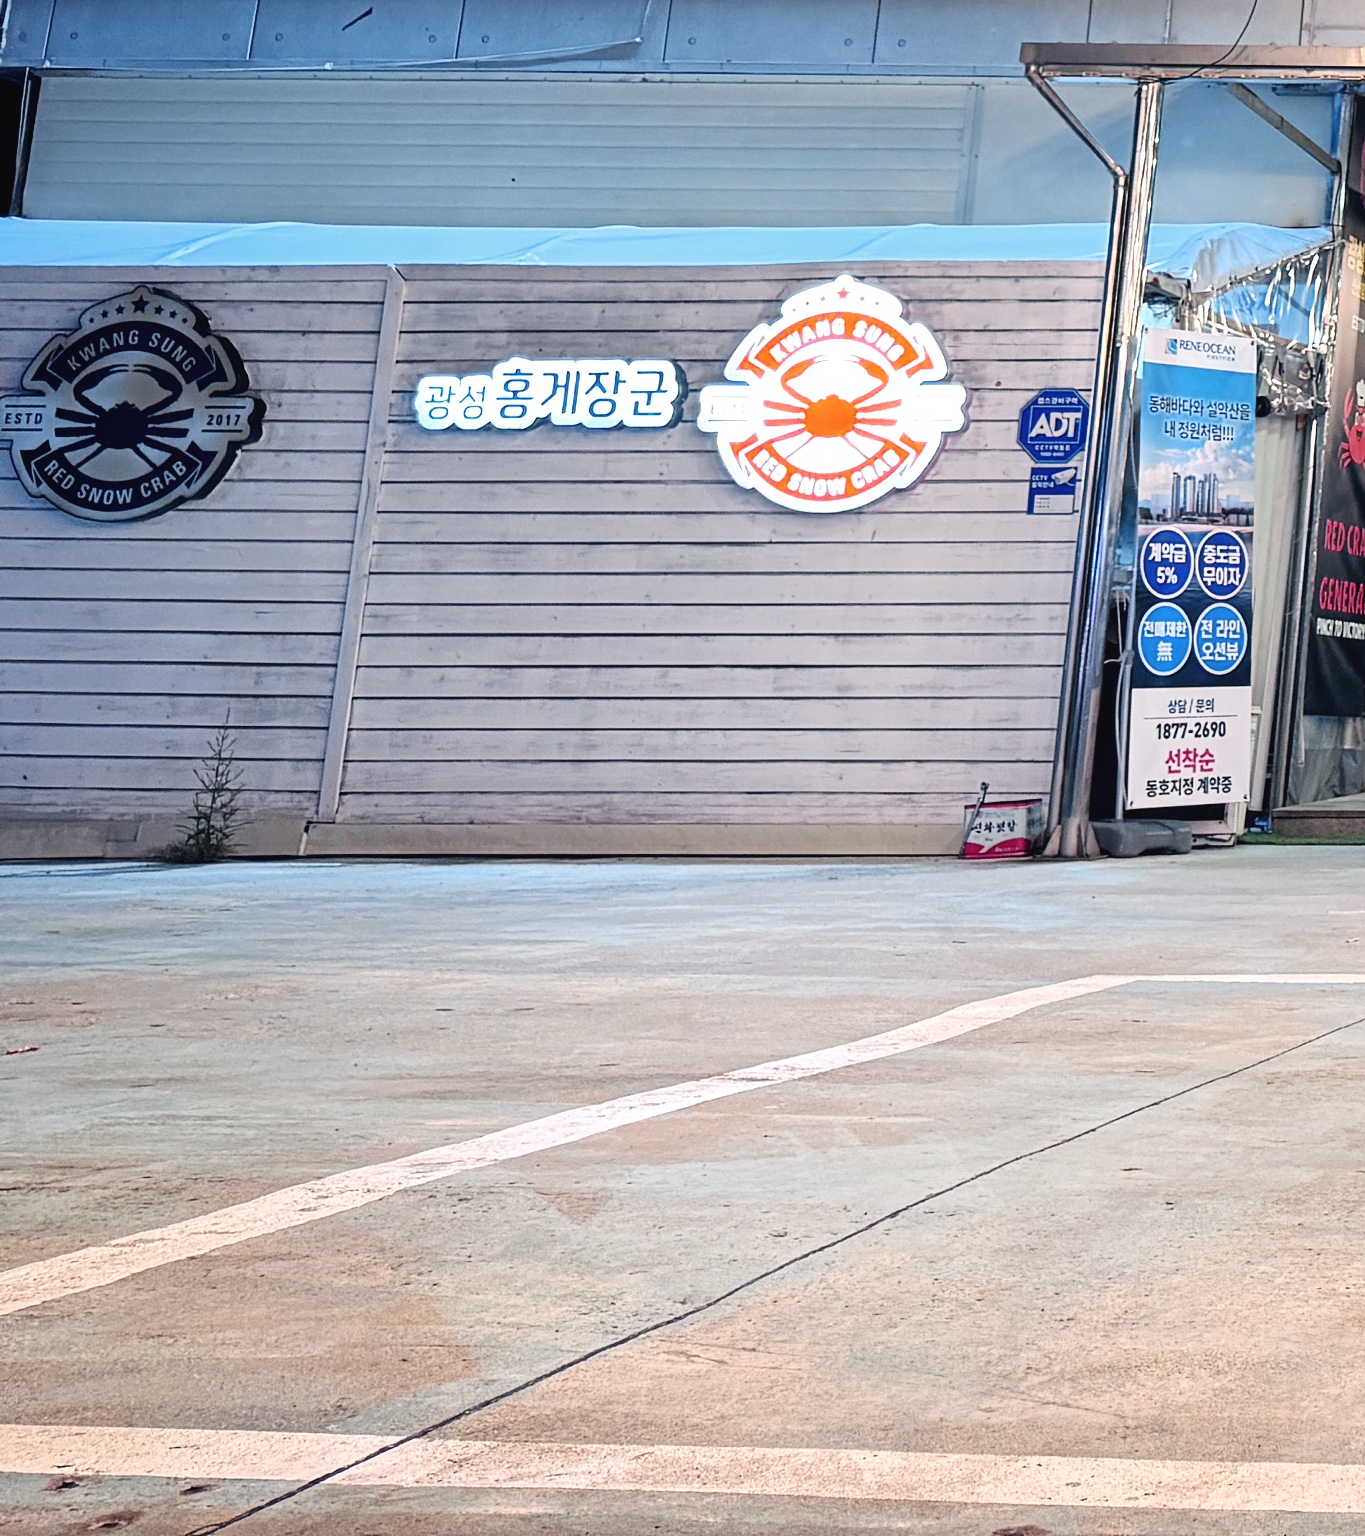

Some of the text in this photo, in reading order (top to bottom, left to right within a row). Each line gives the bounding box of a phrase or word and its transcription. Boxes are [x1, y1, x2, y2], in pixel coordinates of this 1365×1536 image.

[769, 317, 905, 363] KWANG SUNG
[66, 330, 196, 372] KWANG SUNG
[425, 368, 668, 420] 광성 홍게장군
[1149, 395, 1252, 421] 동해바다와 설악산을
[4, 413, 241, 426] ESTD 2017
[1028, 412, 1082, 438] ADT
[1164, 421, 1235, 442] 내 정원처럼!!!
[44, 460, 187, 505] RED SNOW CRAB
[752, 449, 901, 497] RED SNOW CRAB
[1324, 518, 1346, 552] RED
[1148, 542, 1187, 563] 계약금
[1203, 545, 1241, 565] 중도금
[1156, 566, 1178, 584] 5%
[1203, 567, 1241, 586] 무이자
[1200, 620, 1241, 639] 전 라인
[1201, 641, 1239, 661] 오션뷰
[1168, 699, 1187, 714] 상담
[1196, 697, 1215, 713] 문의
[1156, 721, 1226, 740] 1877-2690
[1165, 748, 1215, 774] 선착순
[1145, 776, 1232, 798] 동호지정 계약중
